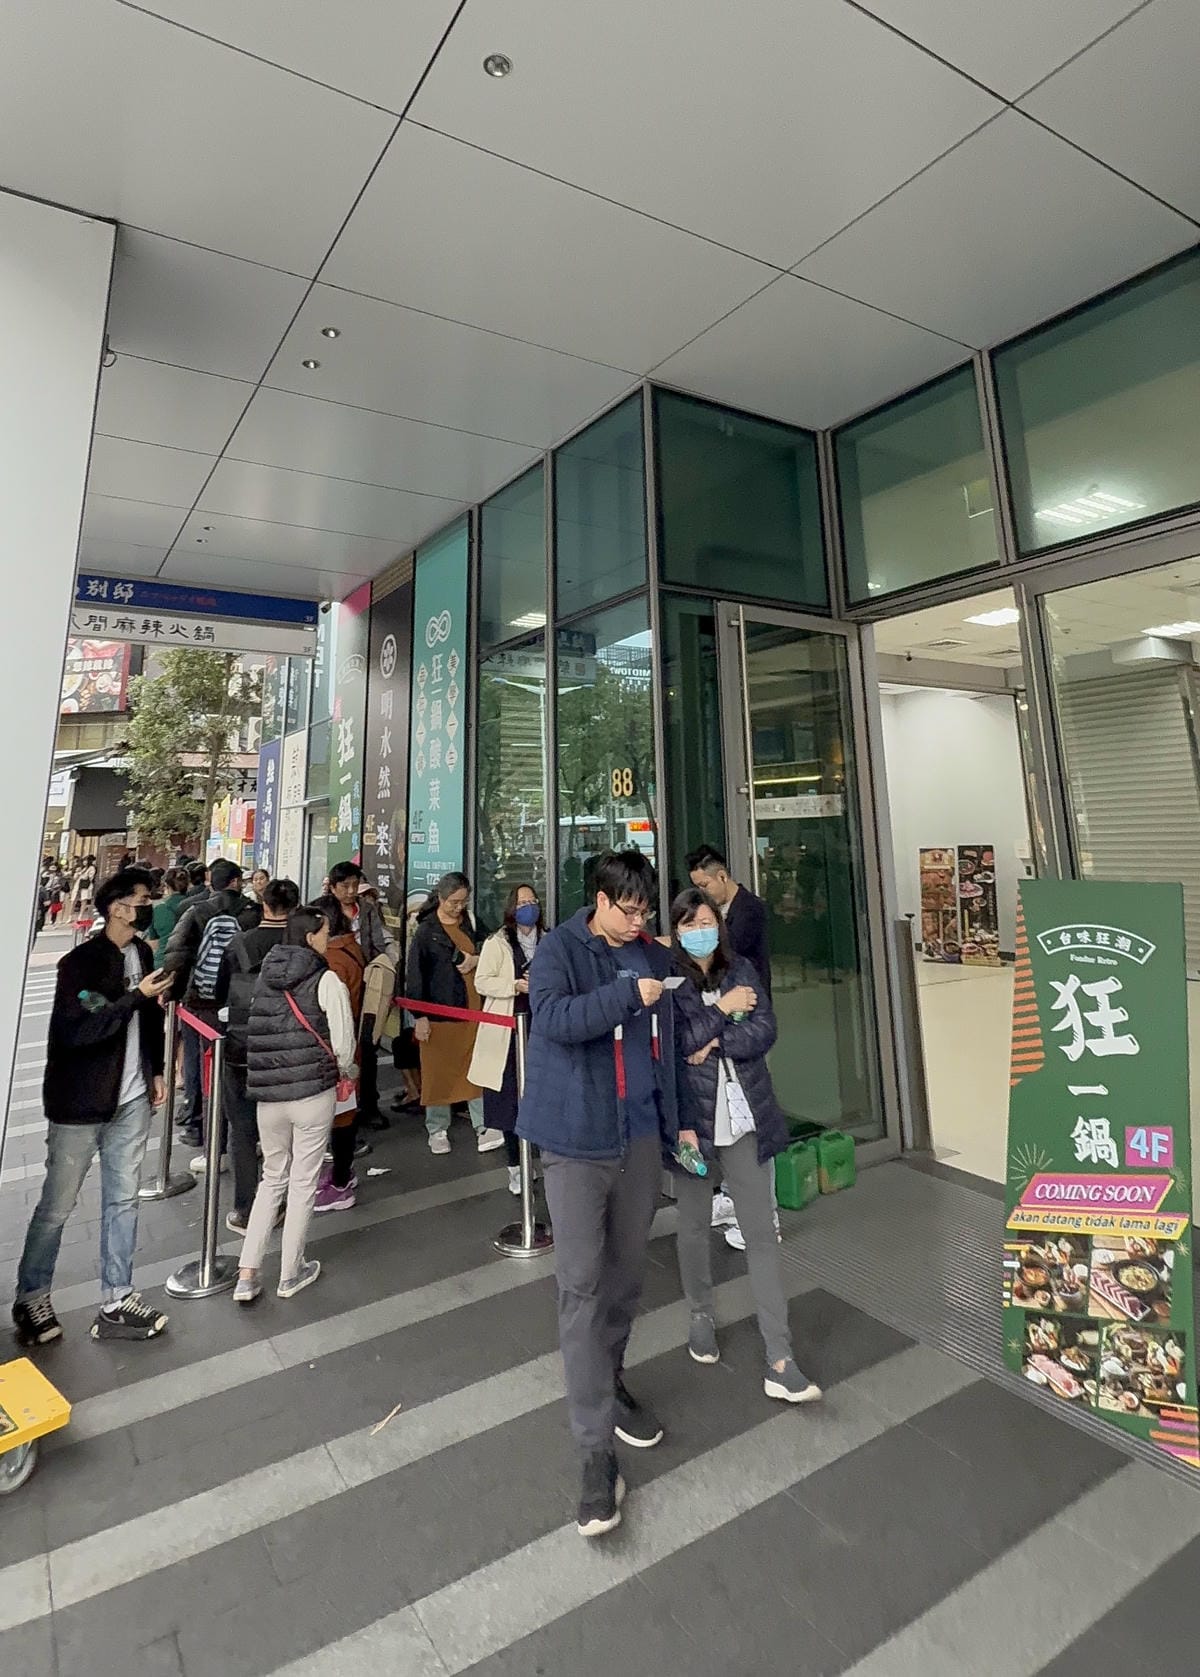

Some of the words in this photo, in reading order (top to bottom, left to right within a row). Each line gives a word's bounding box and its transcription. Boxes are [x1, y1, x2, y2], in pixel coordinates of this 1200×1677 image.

[76, 579, 134, 604] 別邸
[338, 717, 355, 834] 狂一鍋
[612, 767, 633, 797] 88
[1059, 930, 1132, 952] 台味狂潮
[1048, 973, 1141, 1168] 狂一鍋
[1129, 1128, 1169, 1163] 4F
[1035, 1183, 1101, 1201] COMING
[1102, 1185, 1157, 1203] SOON
[1013, 1212, 1039, 1223] akan
[1042, 1213, 1082, 1228] datang
[1085, 1215, 1115, 1227] tidak
[1119, 1217, 1151, 1229] lama
[1153, 1218, 1179, 1233] lagi
